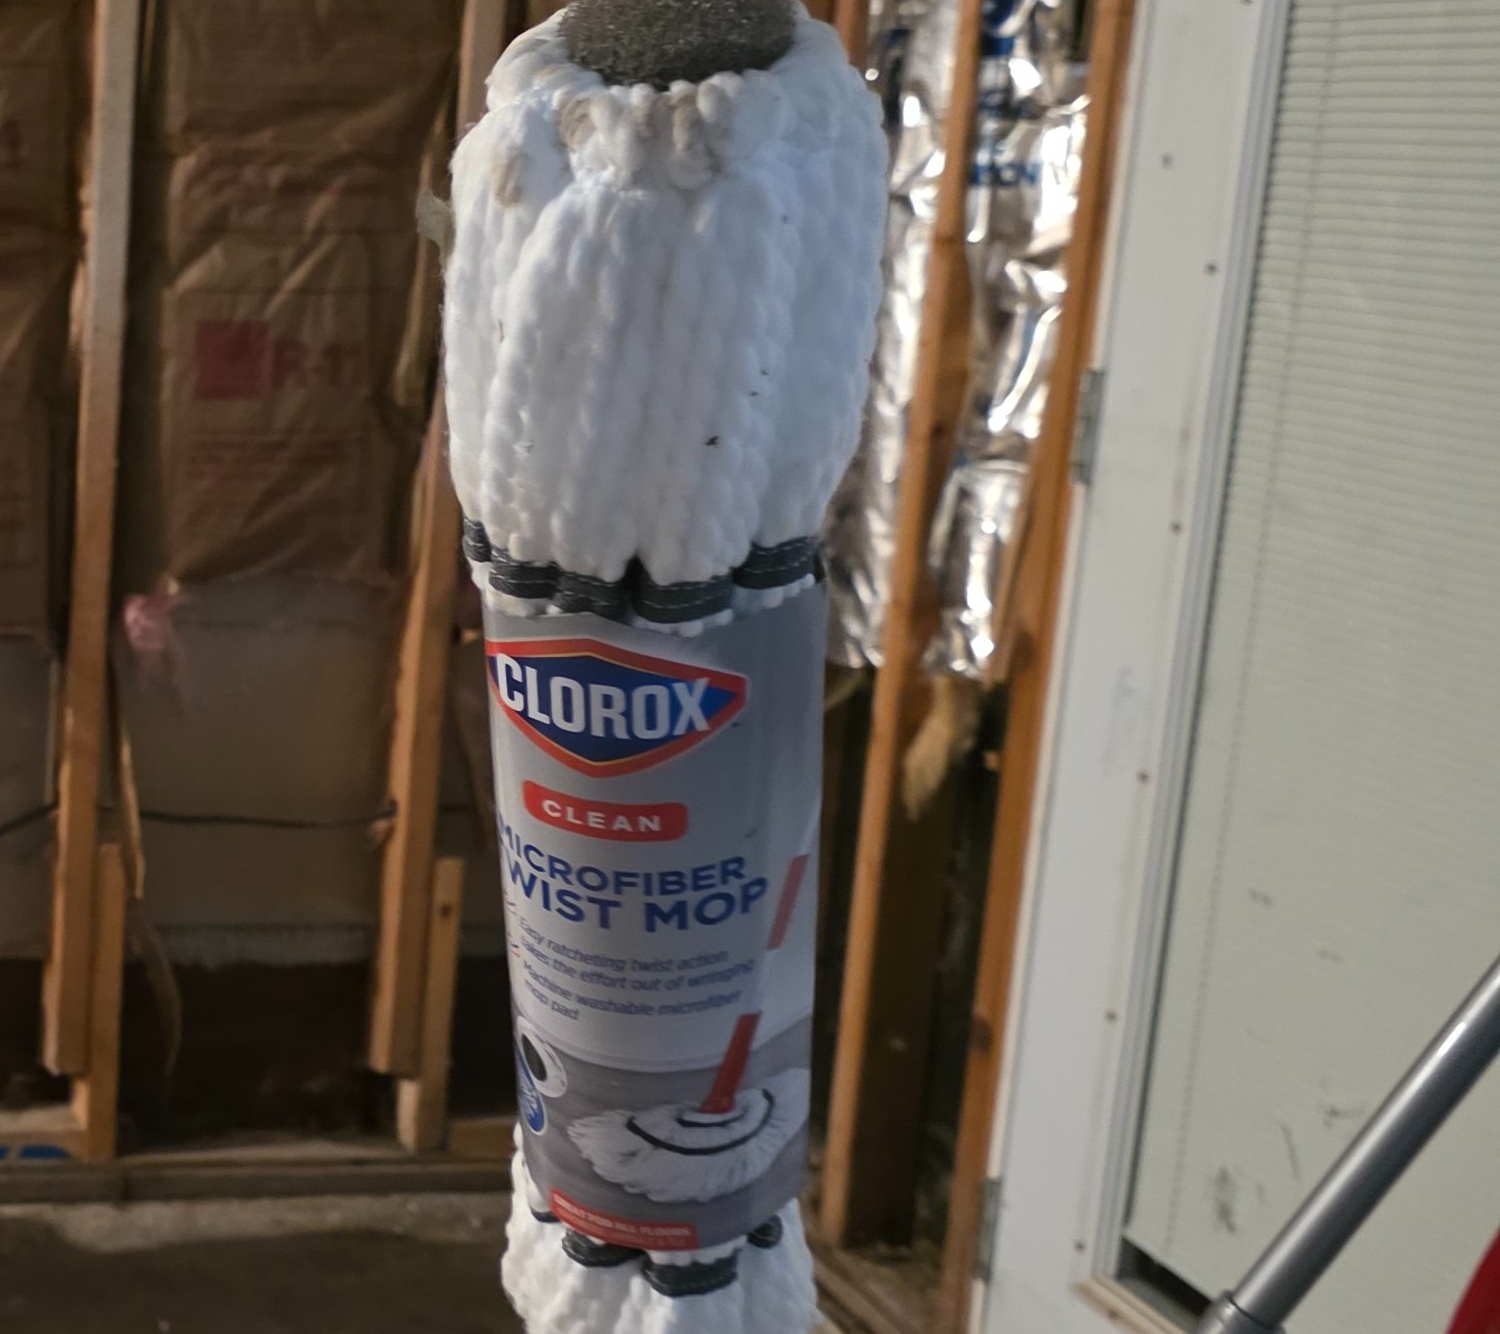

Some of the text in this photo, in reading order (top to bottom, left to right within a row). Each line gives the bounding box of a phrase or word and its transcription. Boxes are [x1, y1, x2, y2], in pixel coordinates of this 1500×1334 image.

[496, 652, 709, 739] CLOROX
[541, 798, 661, 833] CLEAN
[500, 837, 769, 933] WIST MOP
[547, 939, 626, 972] ratcheting
[580, 969, 626, 989] effort
[631, 978, 661, 991] out
[665, 975, 685, 991] of
[576, 994, 654, 1015] washable
